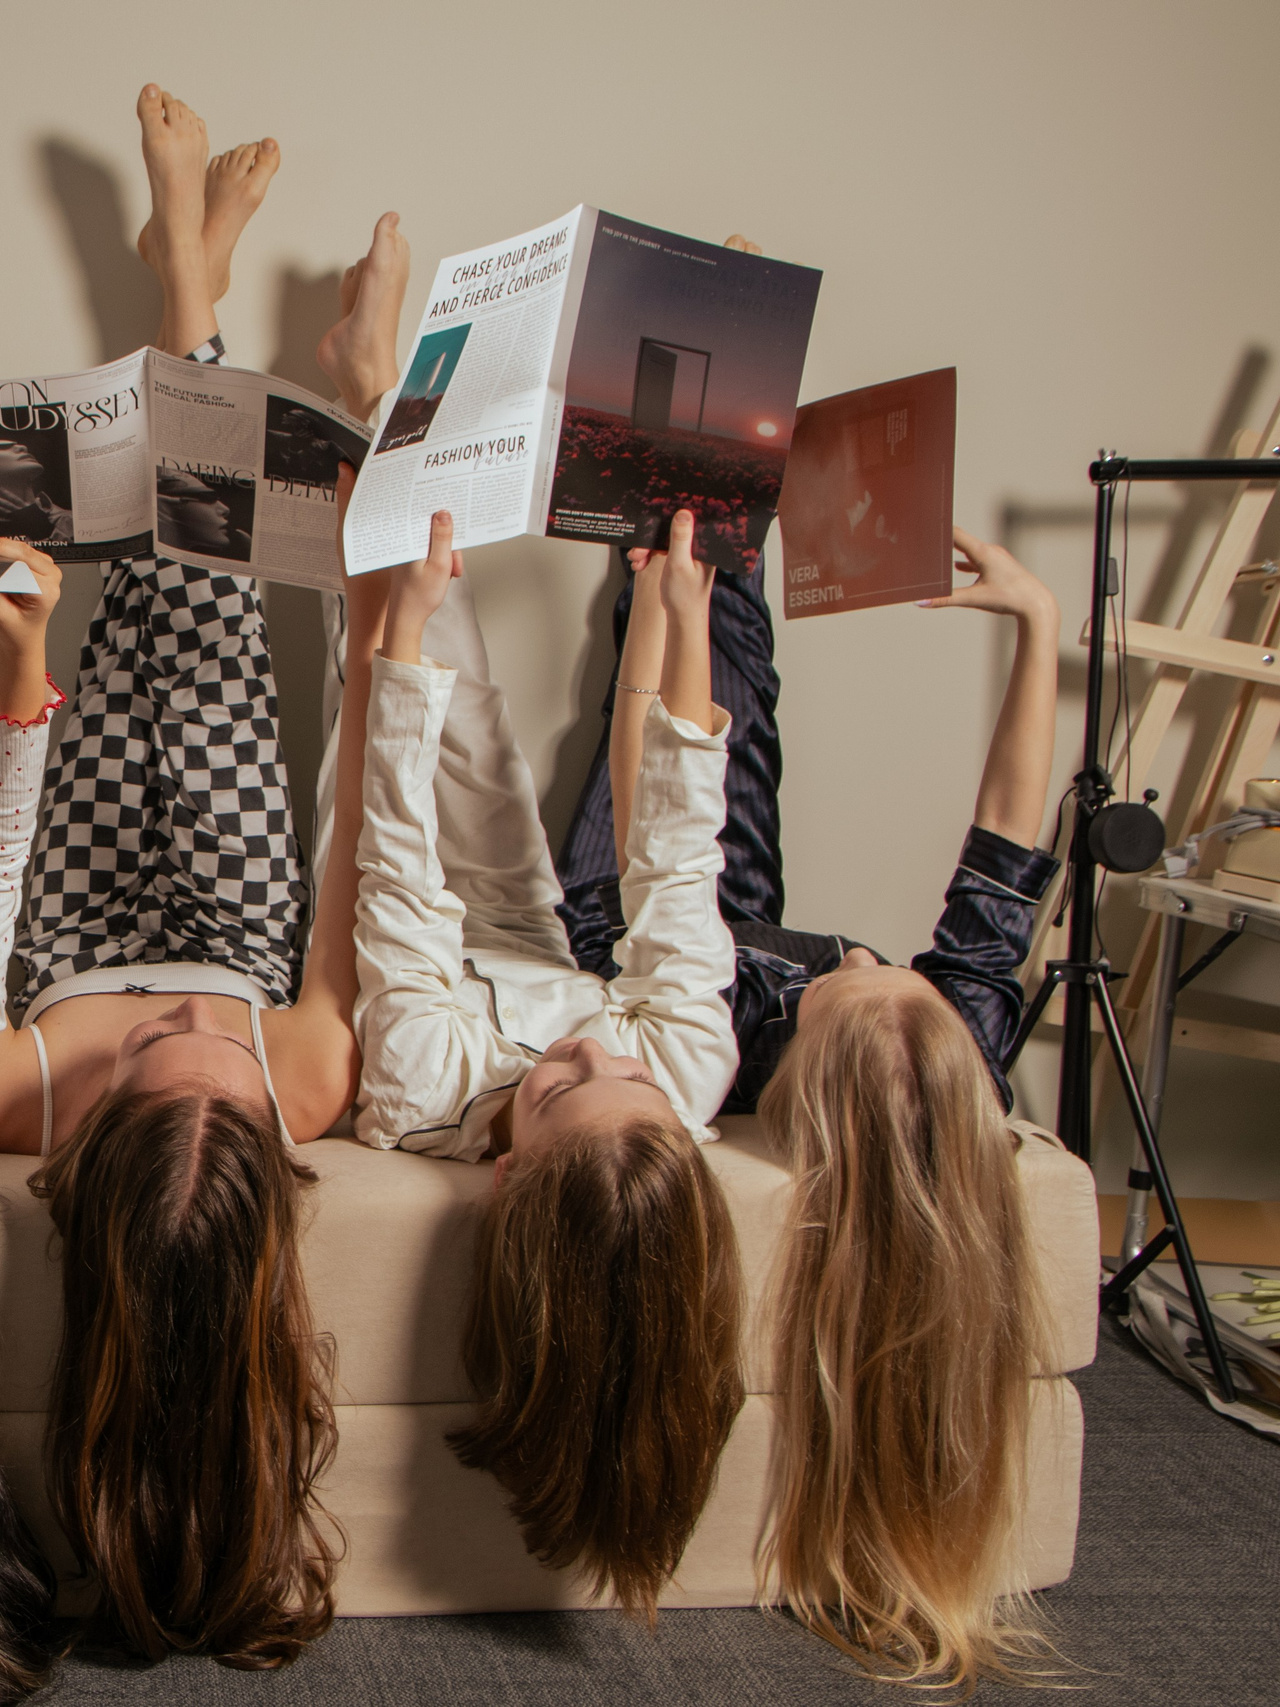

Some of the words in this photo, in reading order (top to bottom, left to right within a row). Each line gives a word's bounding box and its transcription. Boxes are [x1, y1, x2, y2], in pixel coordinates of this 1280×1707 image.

[602, 226, 613, 238] FIND
[613, 229, 623, 240] JOY
[629, 234, 639, 245] THE
[638, 236, 661, 251] JOURNEY
[452, 258, 494, 284] CHASE
[496, 247, 527, 271] YOUR
[529, 226, 568, 260] DREAMS
[428, 297, 459, 319] AND
[461, 282, 504, 309] FIERCE
[507, 253, 568, 295] CONFIDENCE
[154, 380, 170, 391] THE
[173, 387, 209, 399] FUTURE
[154, 387, 192, 402] ETHICAL
[194, 398, 235, 408] FASHION
[424, 442, 483, 469] FASHION
[489, 435, 526, 456] YOUR
[162, 456, 256, 490] DARING
[269, 474, 336, 502] DETAI
[788, 564, 820, 584] VERA
[789, 584, 844, 608] ESSENTIA
